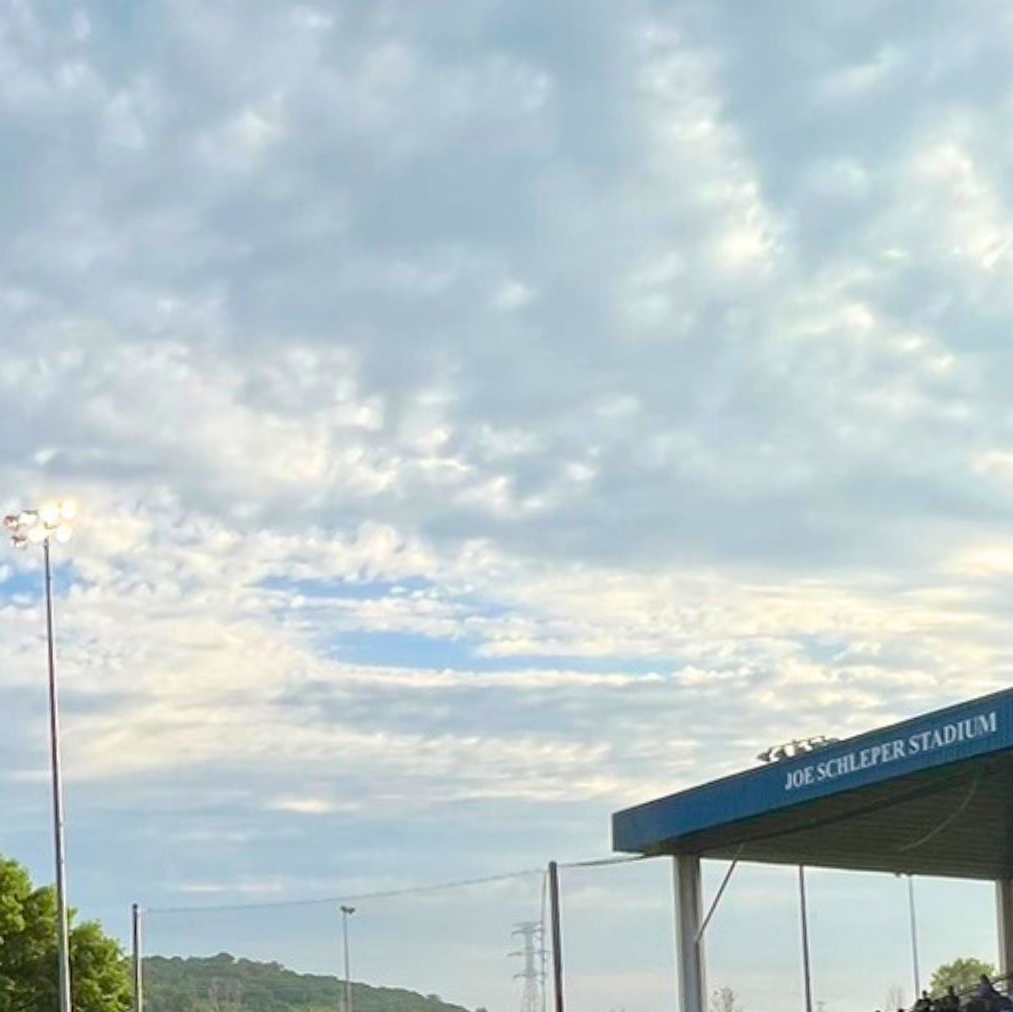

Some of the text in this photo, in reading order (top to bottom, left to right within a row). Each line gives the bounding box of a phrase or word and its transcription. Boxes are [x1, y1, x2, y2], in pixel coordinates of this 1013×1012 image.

[785, 711, 997, 791] JOE SCHLEPER STADIUM
